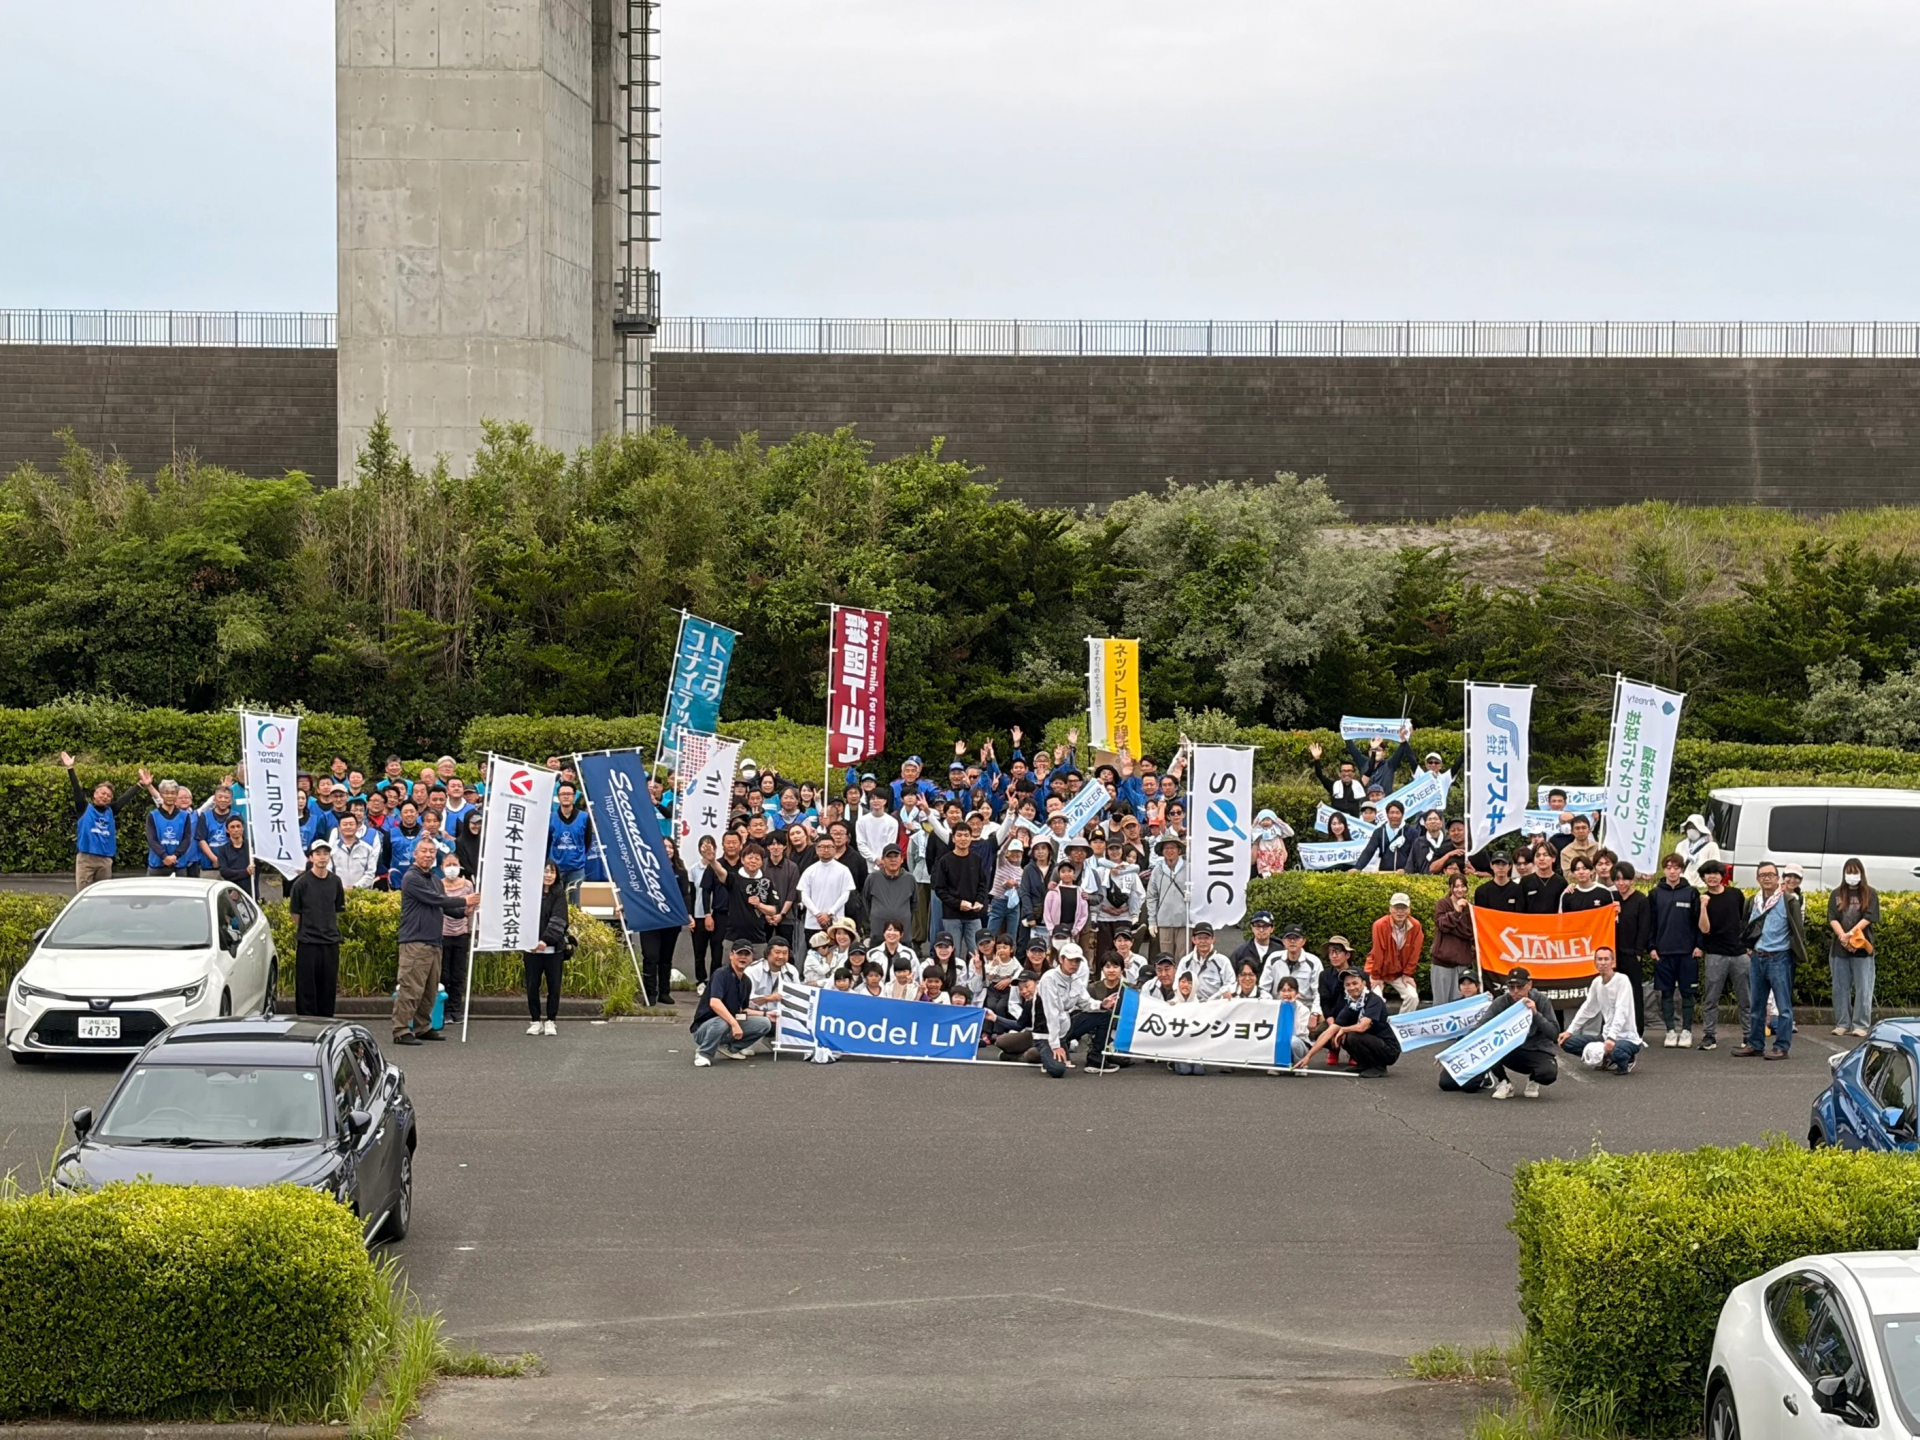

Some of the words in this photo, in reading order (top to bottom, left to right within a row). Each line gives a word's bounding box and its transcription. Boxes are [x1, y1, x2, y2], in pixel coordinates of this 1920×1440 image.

[873, 620, 882, 638] For
[871, 638, 879, 662] your
[701, 636, 727, 701] トヨタ
[868, 665, 879, 694] smile,
[838, 612, 869, 763] 静岡トヨタ
[868, 698, 878, 714] for
[868, 717, 876, 733] our
[258, 750, 284, 758] TOYOTA
[866, 735, 876, 756] smil
[1568, 791, 1608, 804] IONEER
[266, 769, 292, 860] トヨタホーム
[610, 768, 671, 914] SecondStage
[1328, 849, 1361, 861] PIONE
[502, 803, 526, 949] 国本工業株式会社
[1499, 926, 1595, 963] STANLEY
[820, 1015, 918, 1045] model
[931, 1022, 979, 1047] LM
[1169, 1018, 1274, 1041] サンショウ
[1399, 1028, 1418, 1039] BE
[1420, 1026, 1430, 1035] A
[1450, 1062, 1470, 1075] BE
[1470, 1053, 1481, 1064] A
